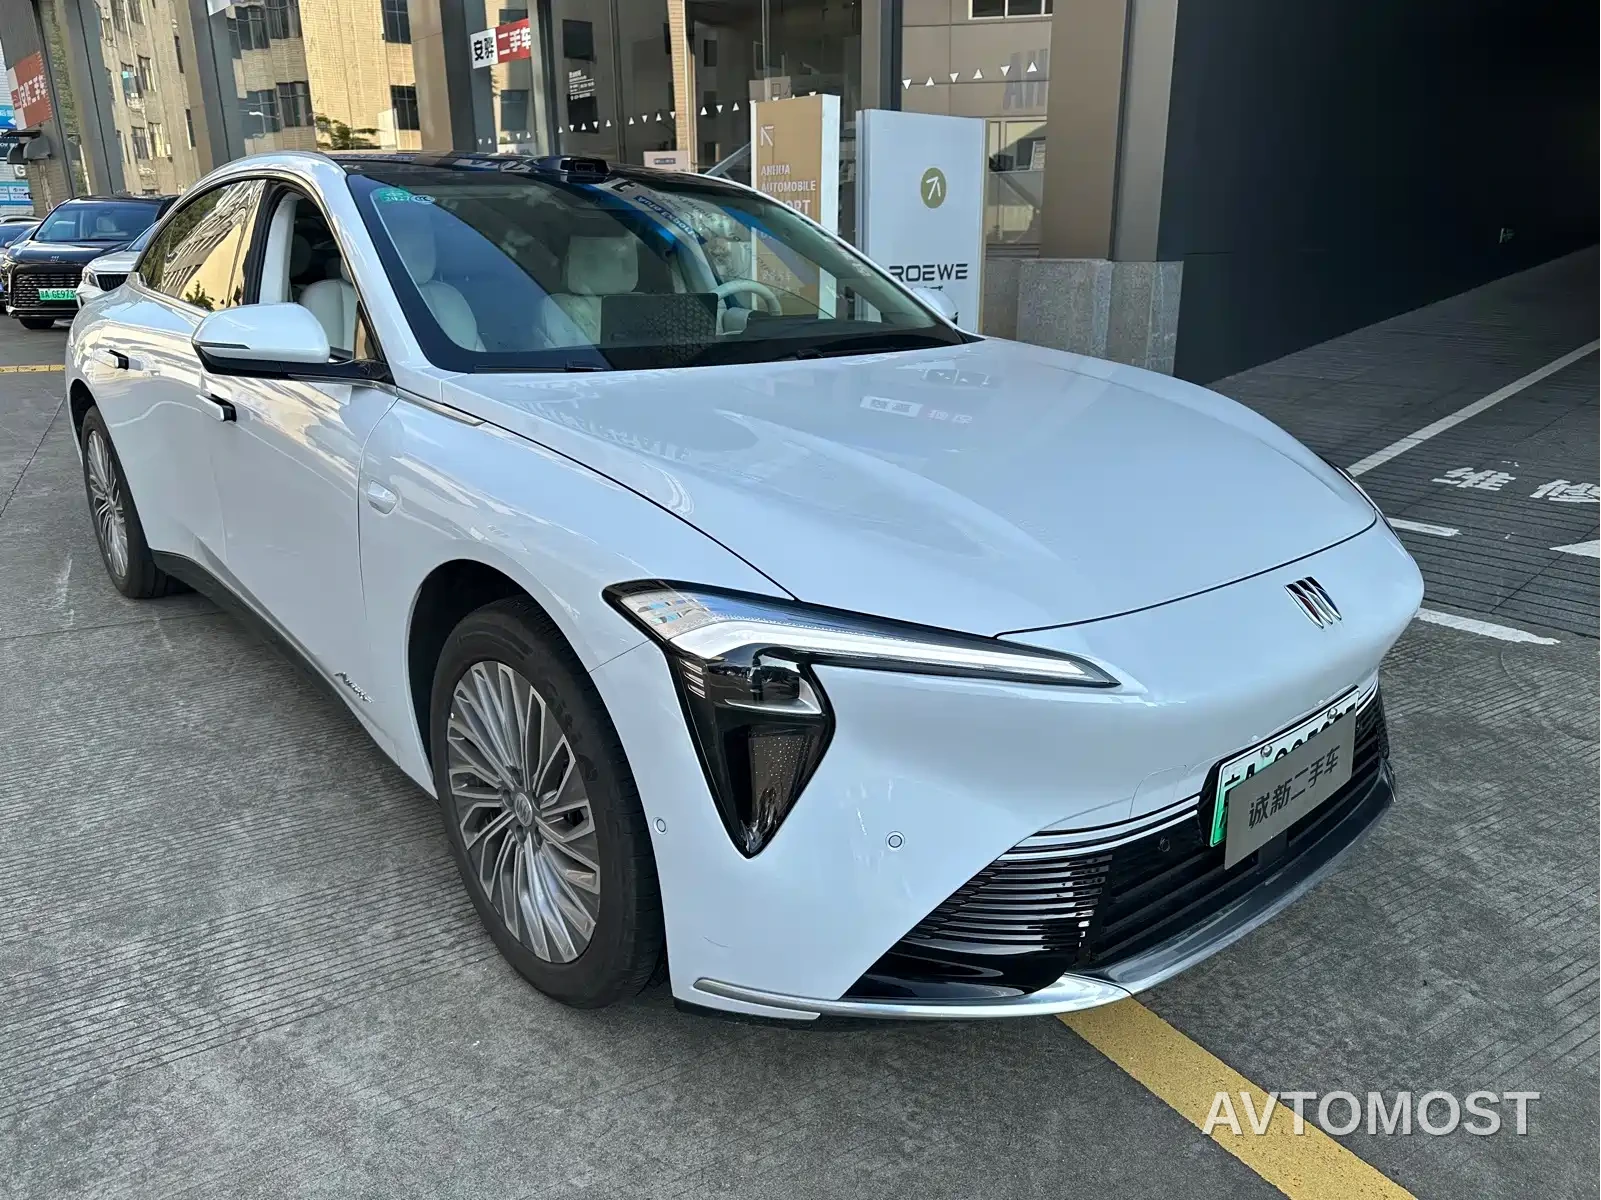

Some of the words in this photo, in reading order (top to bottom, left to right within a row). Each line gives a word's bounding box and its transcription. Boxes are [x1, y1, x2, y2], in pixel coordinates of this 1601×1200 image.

[761, 164, 790, 176] ANHUA
[761, 180, 816, 193] AUTOMOBILE
[889, 263, 968, 282] ROEWE
[1248, 744, 1341, 829] 诚新二手车
